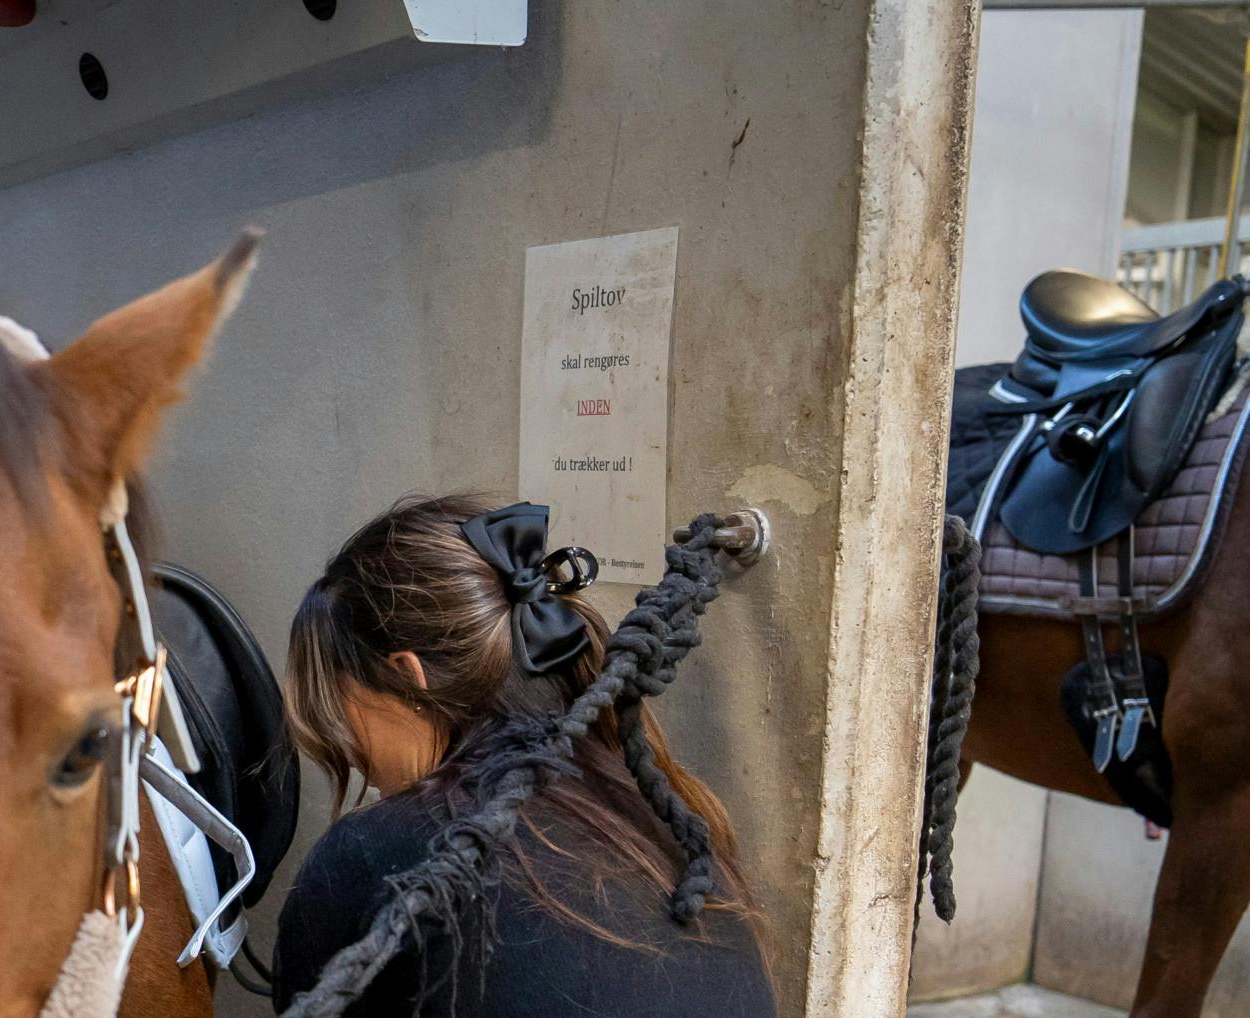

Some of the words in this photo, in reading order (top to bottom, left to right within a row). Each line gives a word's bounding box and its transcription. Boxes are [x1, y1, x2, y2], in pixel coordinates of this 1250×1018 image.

[571, 285, 627, 315] Spiltov
[561, 354, 581, 370] skal
[584, 354, 630, 372] rengøres
[577, 399, 611, 416] INDEN
[554, 456, 567, 471] du
[569, 456, 611, 471] trækker
[612, 456, 626, 472] ud
[611, 558, 645, 570] Bestyrelsen
